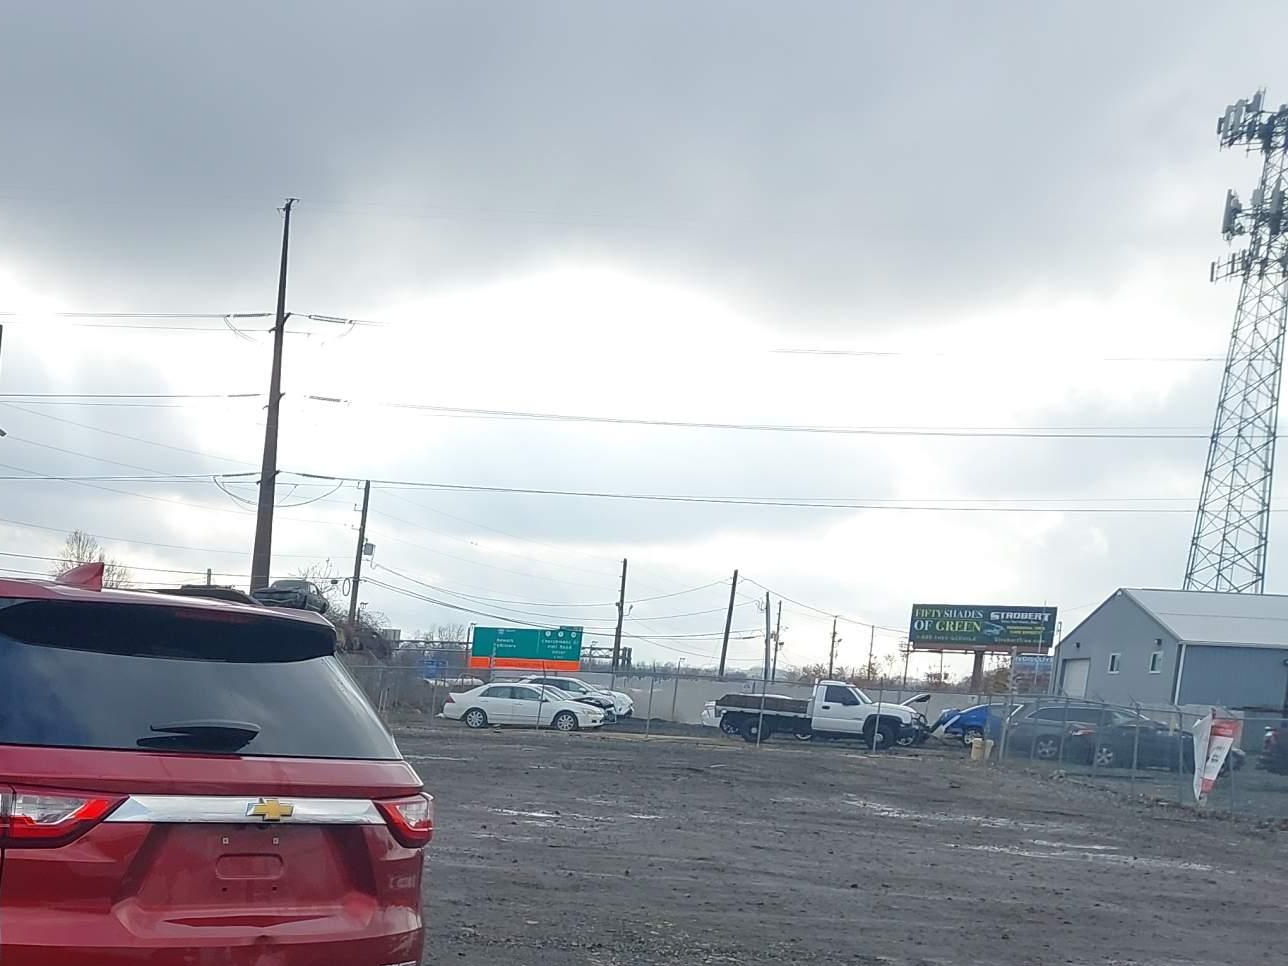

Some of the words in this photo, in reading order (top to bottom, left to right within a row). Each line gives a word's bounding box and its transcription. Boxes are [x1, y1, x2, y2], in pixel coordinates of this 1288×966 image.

[915, 608, 942, 617] FIFTY
[943, 608, 985, 619] SHADES
[990, 612, 1052, 622] STROBERT
[914, 619, 934, 631] OF
[935, 619, 982, 632] GREEN
